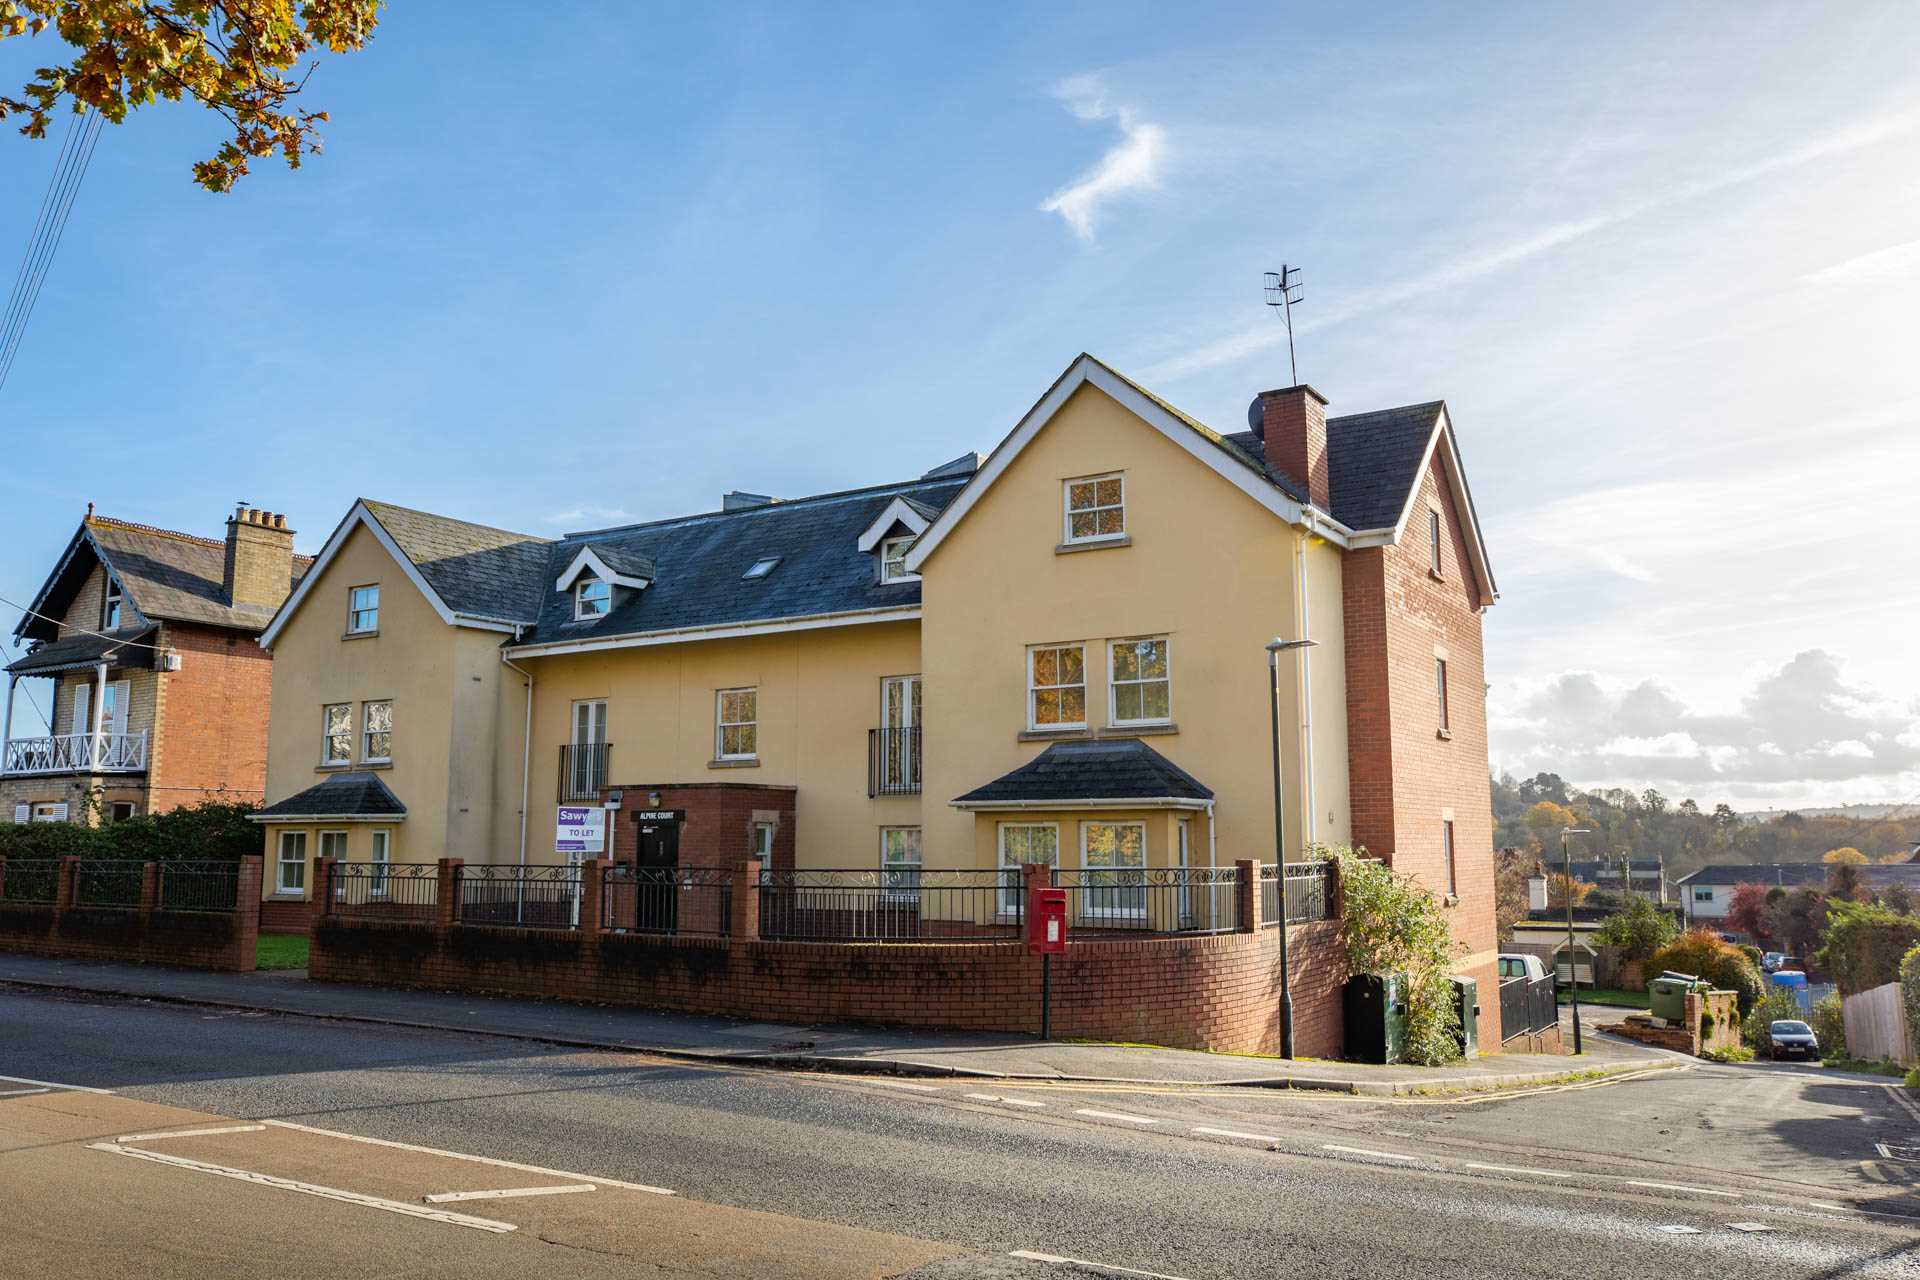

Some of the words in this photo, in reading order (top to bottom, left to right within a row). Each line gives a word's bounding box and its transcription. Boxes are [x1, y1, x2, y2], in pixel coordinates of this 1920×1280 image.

[560, 811, 601, 822] Sawy
[569, 829, 579, 837] TO
[582, 829, 594, 837] LET
